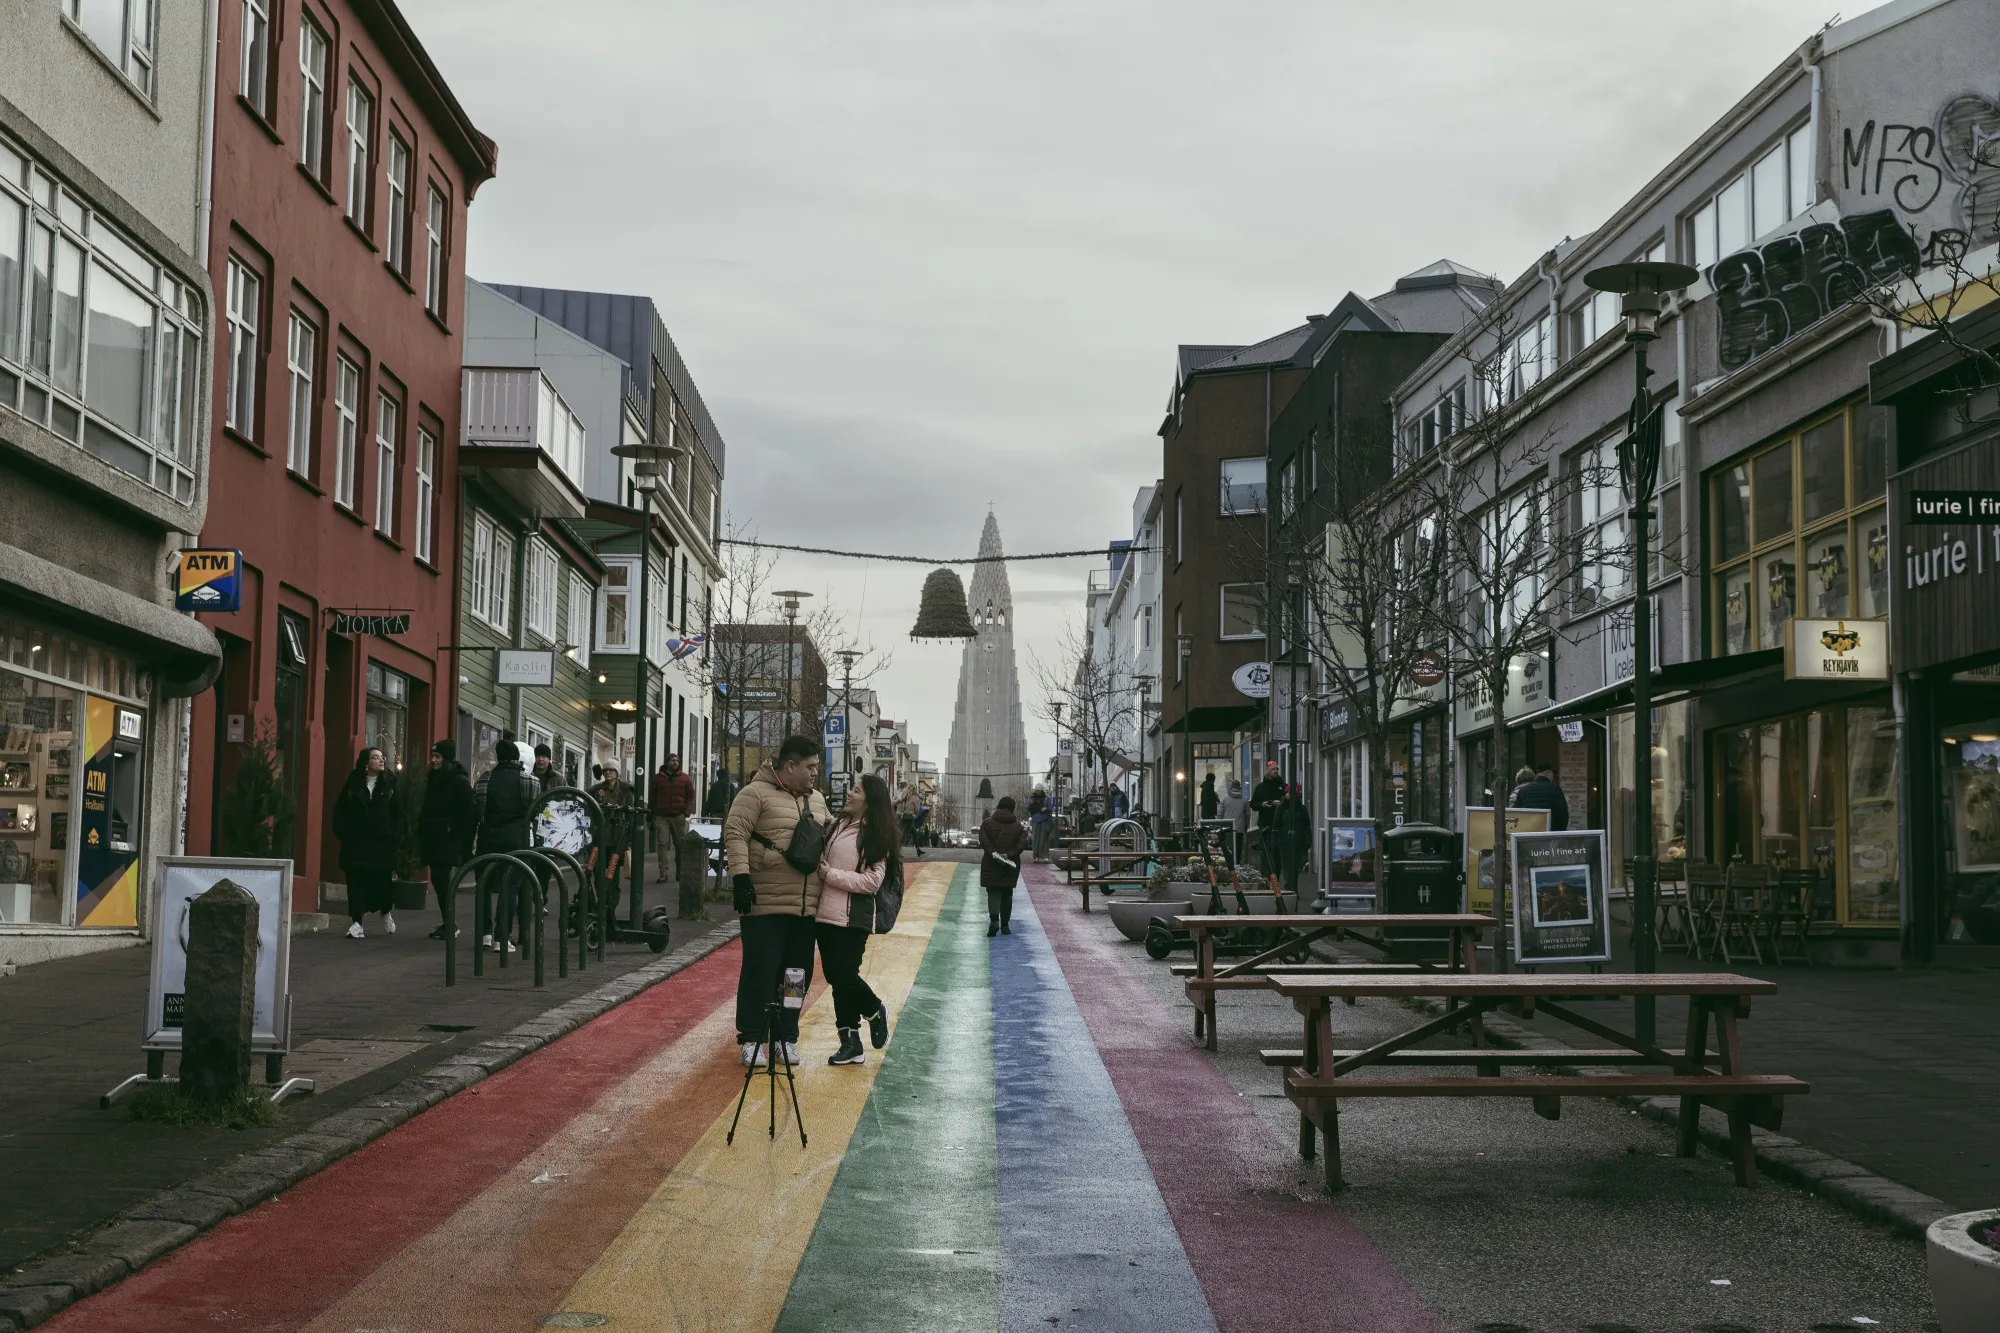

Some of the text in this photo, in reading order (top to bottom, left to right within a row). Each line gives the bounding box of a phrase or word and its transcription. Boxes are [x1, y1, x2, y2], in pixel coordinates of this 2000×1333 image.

[1844, 119, 1942, 214] MFS
[1916, 497, 1962, 514] iurie
[186, 555, 229, 570] ATM
[1906, 531, 1967, 589] iurie
[336, 614, 407, 636] MOKKA
[505, 660, 548, 673] Kaolin
[1615, 655, 1635, 680] Icela
[1823, 656, 1859, 675] REYKJAVÍK
[121, 715, 138, 735] ATM
[1330, 706, 1348, 729] Blondie
[86, 770, 107, 793] ATM
[1531, 849, 1550, 857] iurie
[1557, 847, 1573, 856] fine
[200, 867, 222, 877] AND
[166, 996, 185, 1004] ANN
